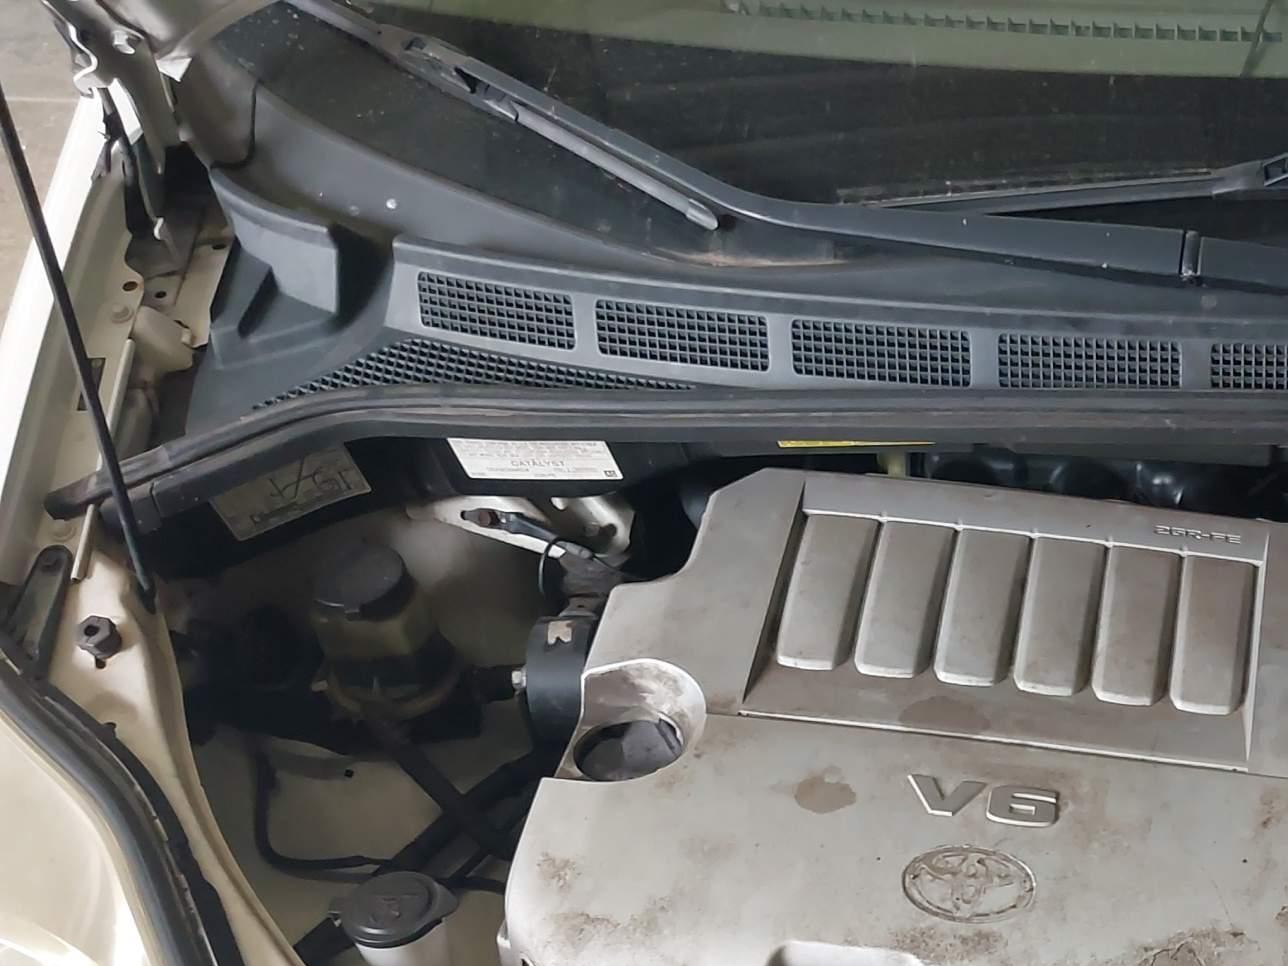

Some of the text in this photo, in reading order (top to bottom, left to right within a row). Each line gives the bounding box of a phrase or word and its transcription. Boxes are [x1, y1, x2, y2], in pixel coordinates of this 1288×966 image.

[511, 458, 566, 467] CATALYST
[1154, 524, 1241, 544] 2GR-FE
[907, 774, 1060, 829] V6
